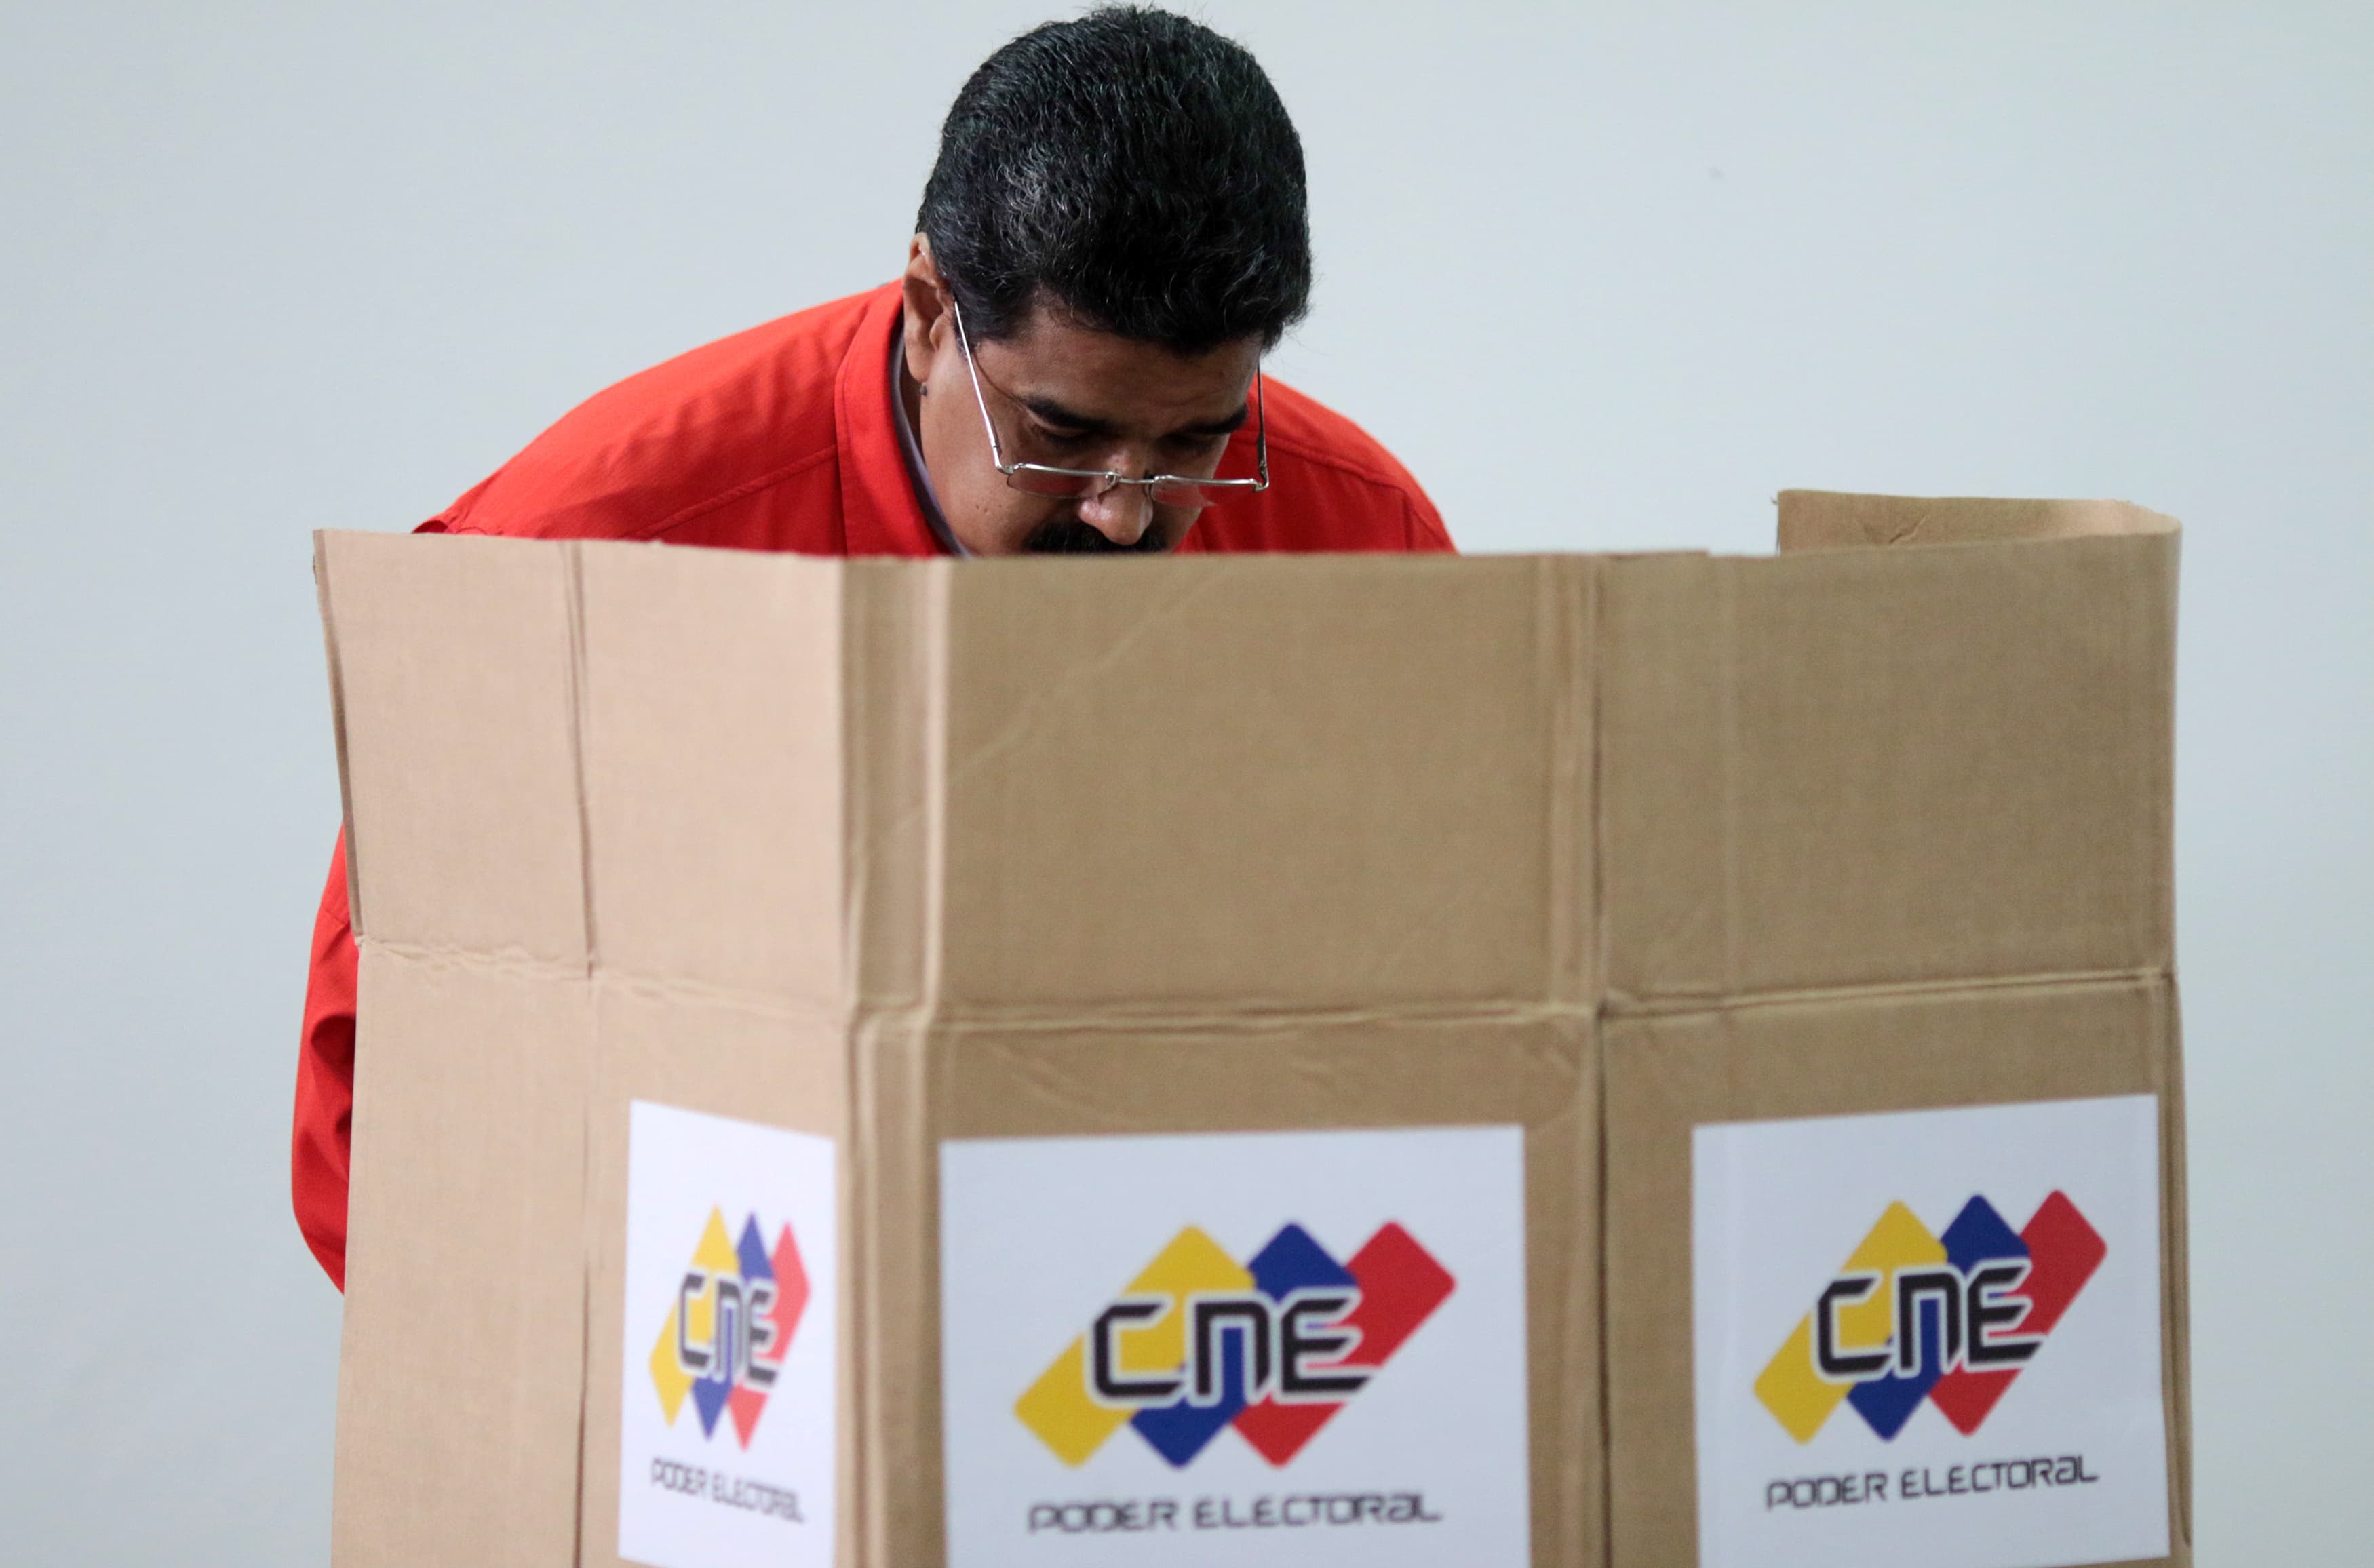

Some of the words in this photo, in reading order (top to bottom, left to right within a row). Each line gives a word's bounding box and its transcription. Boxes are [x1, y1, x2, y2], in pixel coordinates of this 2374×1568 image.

[680, 1272, 777, 1385] CNE
[1094, 1299, 1371, 1397] CNE
[1817, 1266, 2042, 1375] CNE
[651, 1457, 706, 1497] PODER
[712, 1470, 805, 1523] ELECTORAL
[1028, 1500, 1178, 1534] PODER
[1194, 1493, 1444, 1529] ELECTORAL
[1767, 1472, 1888, 1510] PODER
[1901, 1455, 2099, 1499] ELECTORAL
